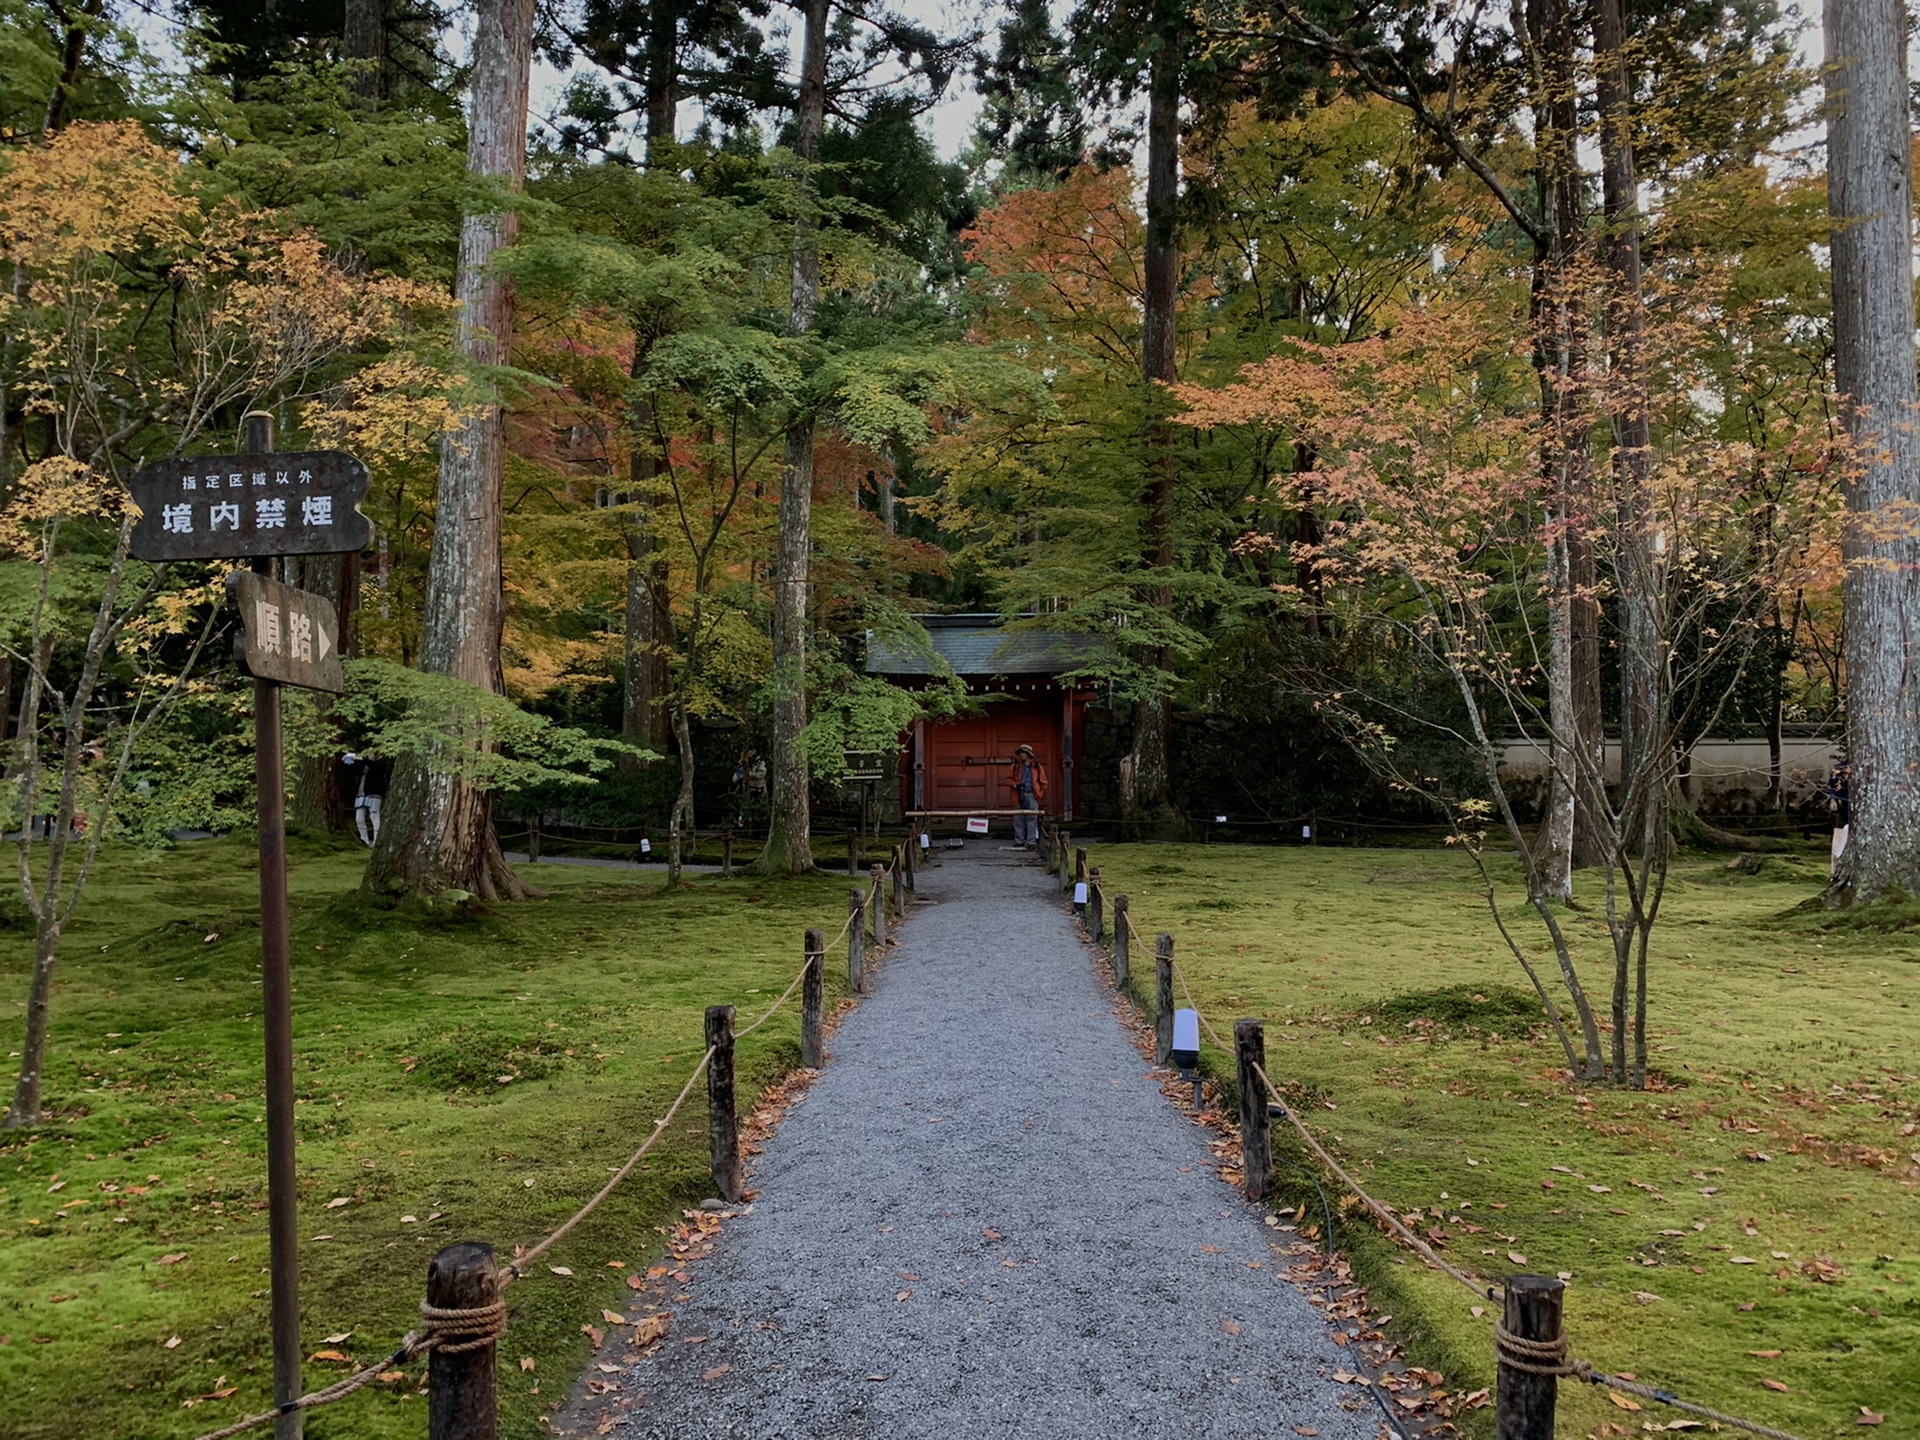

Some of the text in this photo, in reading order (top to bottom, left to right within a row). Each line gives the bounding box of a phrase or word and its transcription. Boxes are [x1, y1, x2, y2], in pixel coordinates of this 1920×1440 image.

[183, 470, 312, 490] 指定区域以外
[162, 496, 333, 533] 境内禁煙
[255, 600, 312, 663] 順路
